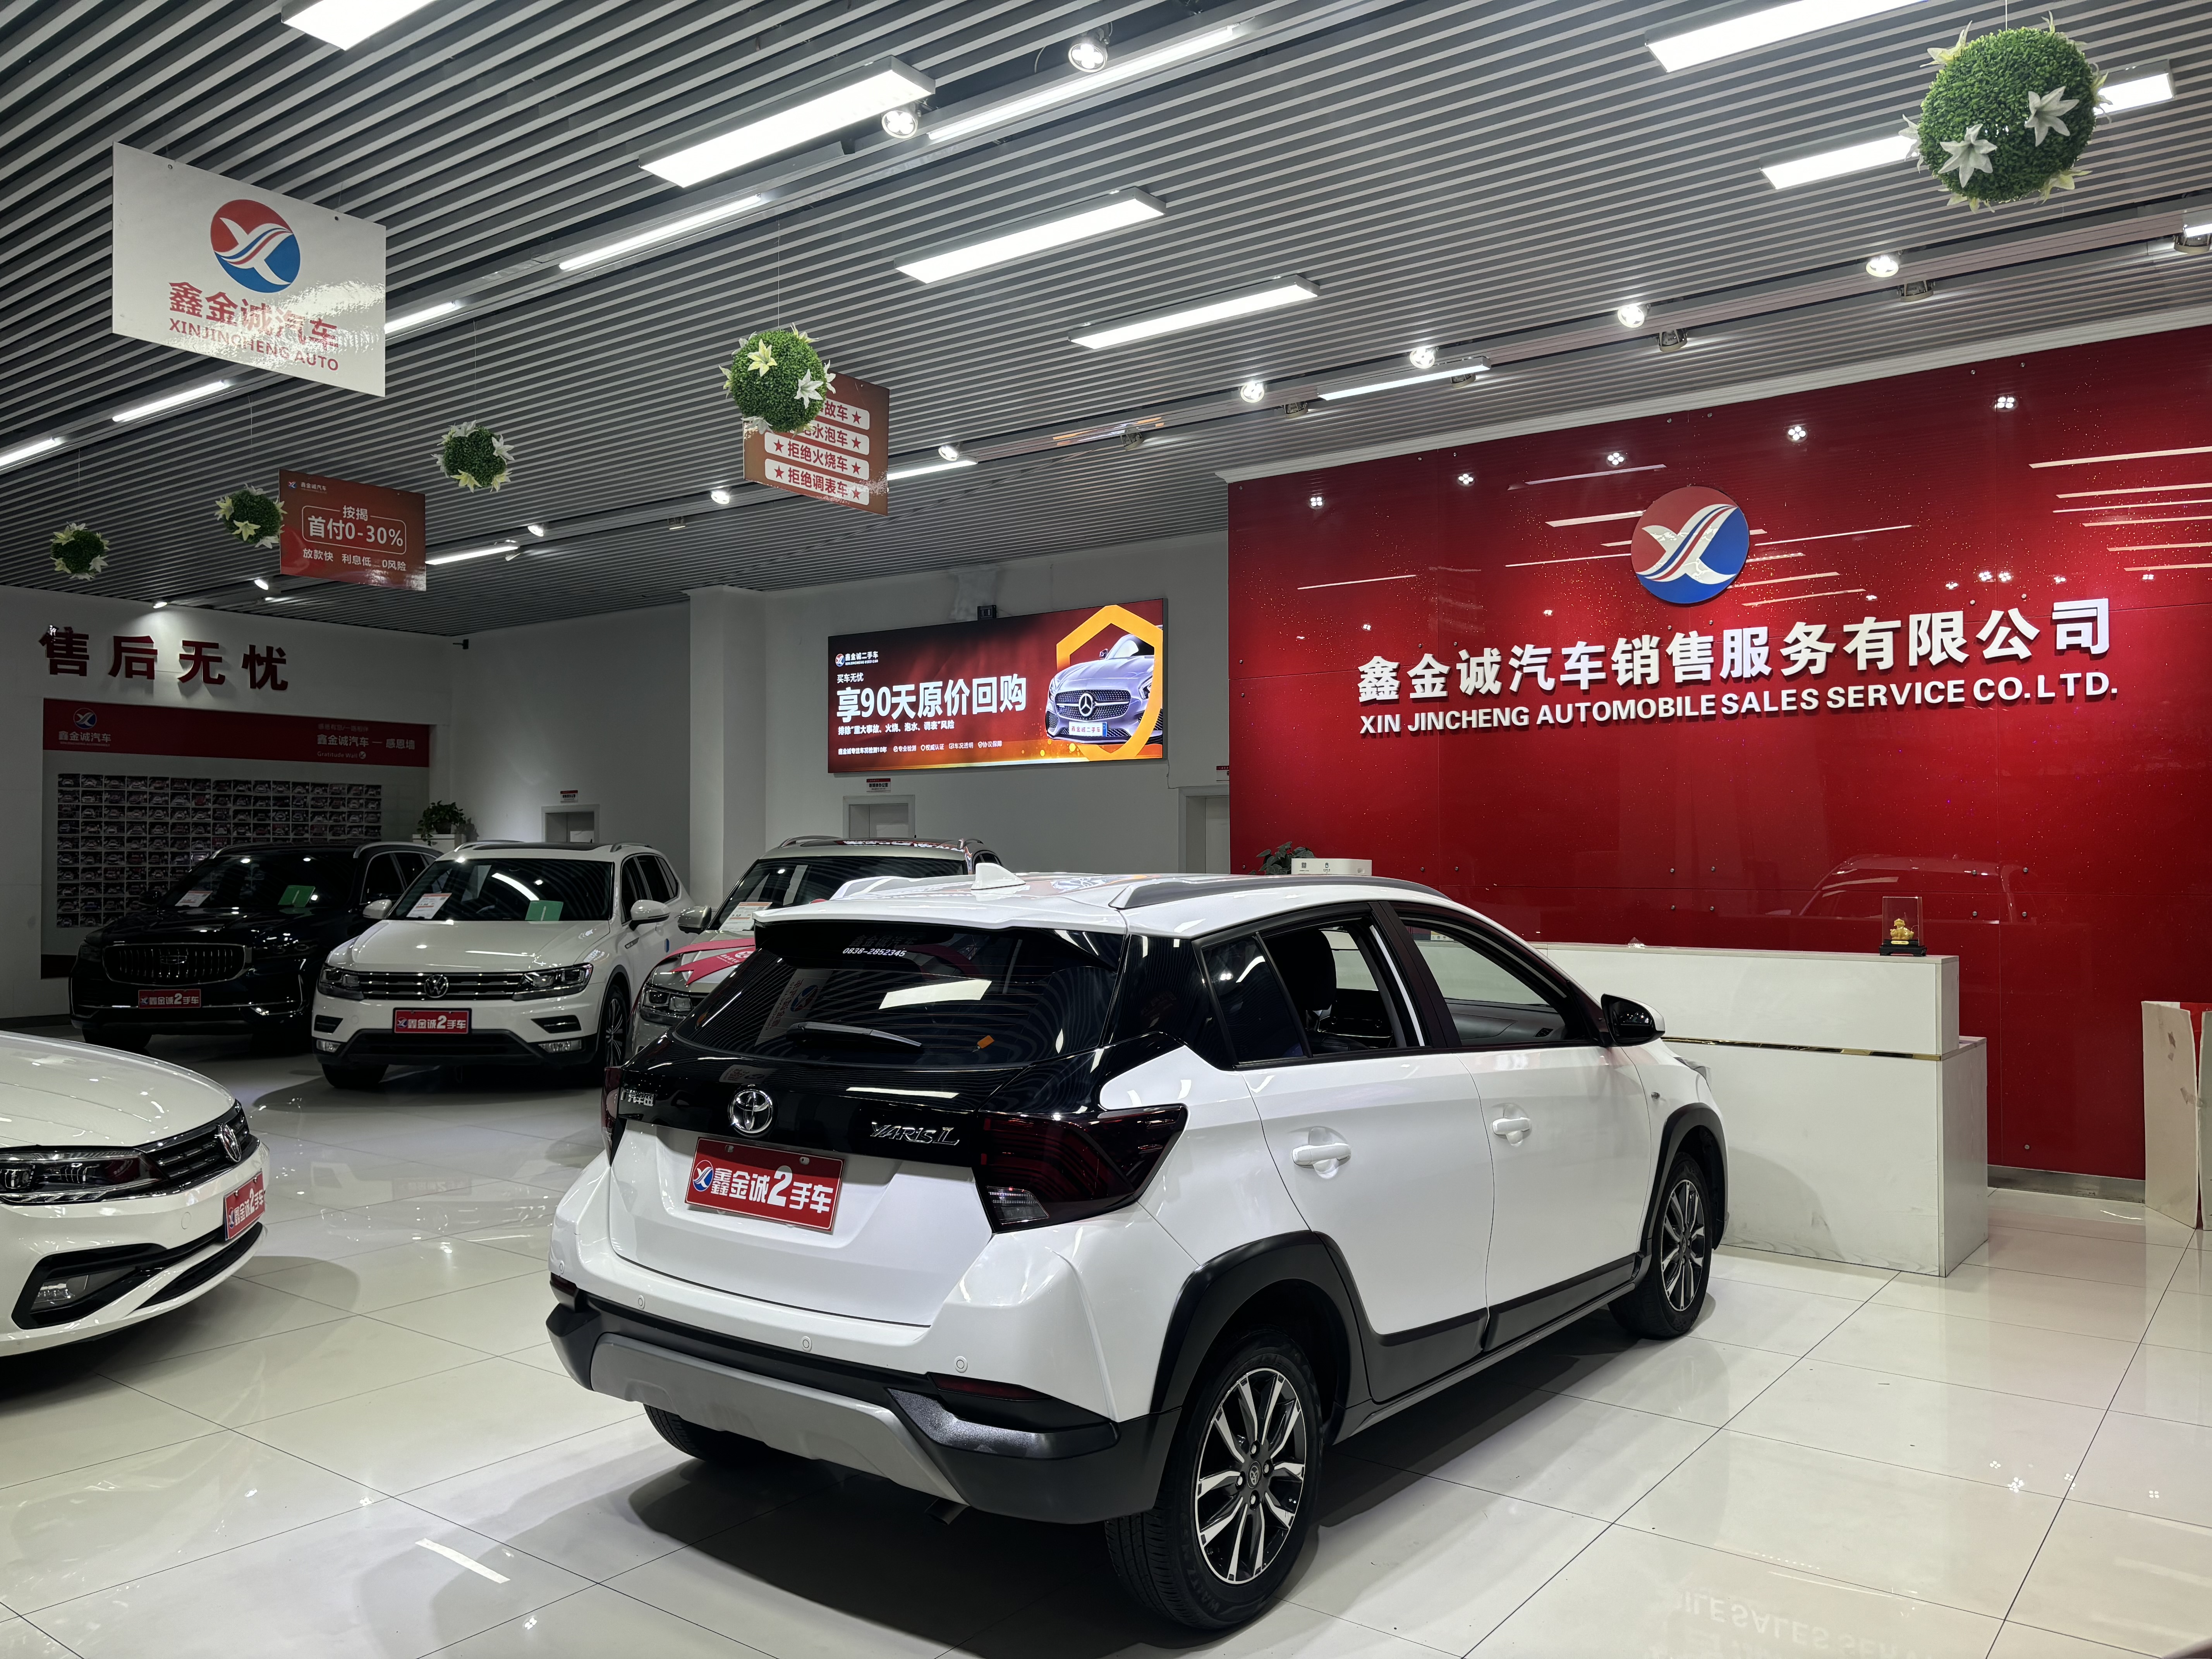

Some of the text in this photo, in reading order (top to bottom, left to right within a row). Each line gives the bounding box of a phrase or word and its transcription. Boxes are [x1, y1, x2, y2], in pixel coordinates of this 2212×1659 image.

[169, 282, 339, 350] 鑫金诚汽车
[295, 353, 338, 371] AUTO
[821, 400, 848, 421] 故车
[788, 441, 848, 472] 拒绝火烧车
[788, 467, 848, 497] 拒绝调表车
[343, 505, 368, 521] 按揭
[308, 515, 403, 546] 首付0-30%
[303, 548, 406, 571] 放款快 利息低 0风险
[39, 625, 289, 690] 售后无忧
[1358, 598, 2109, 702] 鑫金诚汽车销售服务有限公司
[837, 672, 864, 684] 买车无忧
[836, 673, 1027, 723] 享90天原价回购
[1360, 713, 1401, 734] XIN
[1407, 706, 1530, 732] JINCHENG
[1536, 694, 1716, 725] AUTOMOBILE
[1721, 688, 1819, 715] SALES
[1826, 679, 1965, 709] SERVICE
[842, 947, 907, 957] 0838-2852345
[711, 1165, 833, 1214] 鑫金诚2手车
